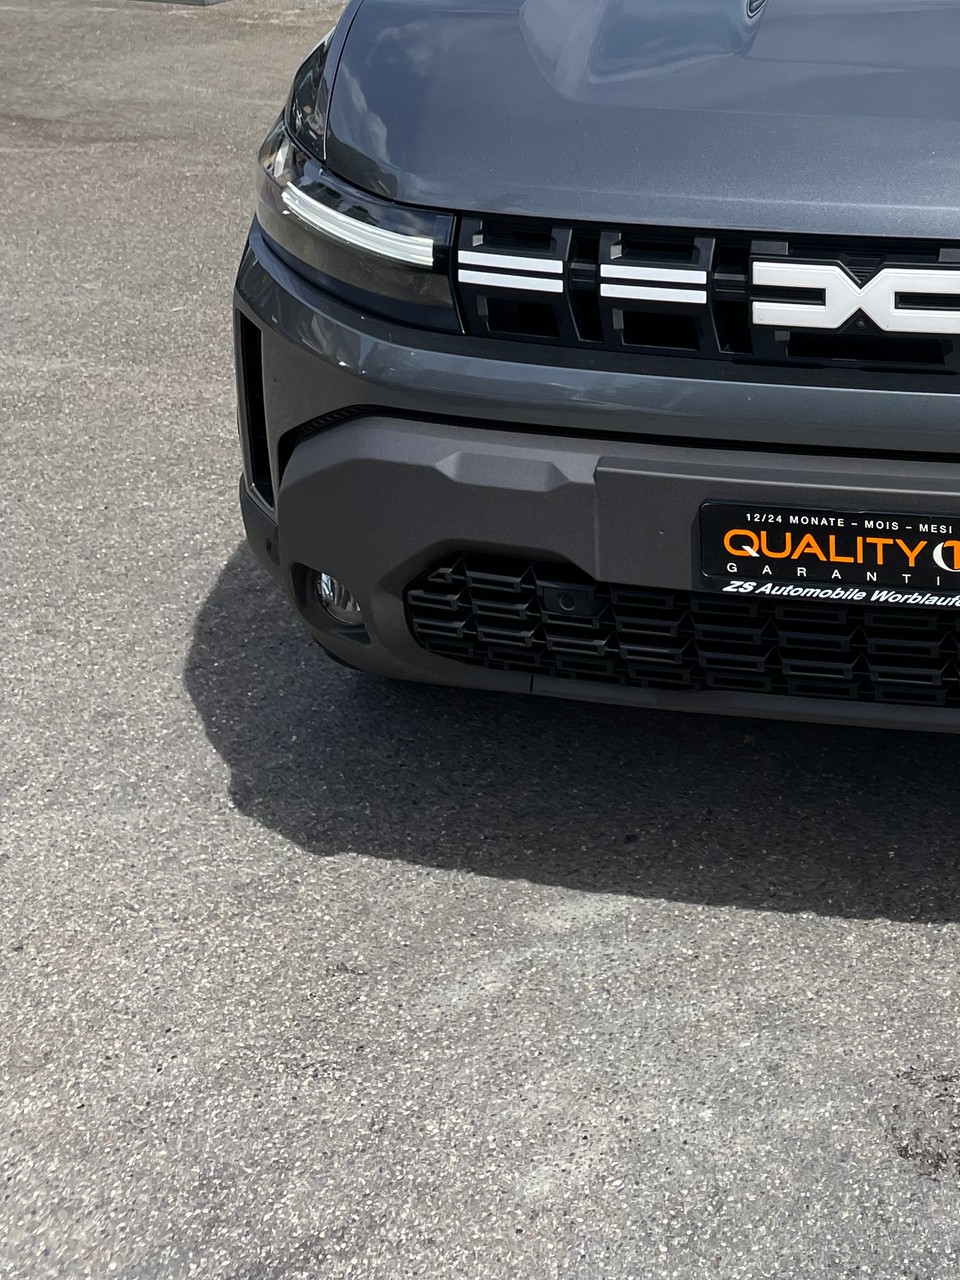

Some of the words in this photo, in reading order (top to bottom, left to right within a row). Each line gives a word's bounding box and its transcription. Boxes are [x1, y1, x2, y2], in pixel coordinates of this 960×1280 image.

[746, 513, 783, 524] 12/24
[789, 515, 845, 527] MONATE
[864, 519, 899, 531] MOIS
[919, 523, 953, 534] MESI
[723, 528, 928, 567] QUALITY
[722, 580, 757, 593] ZS
[755, 581, 866, 601] Automobile
